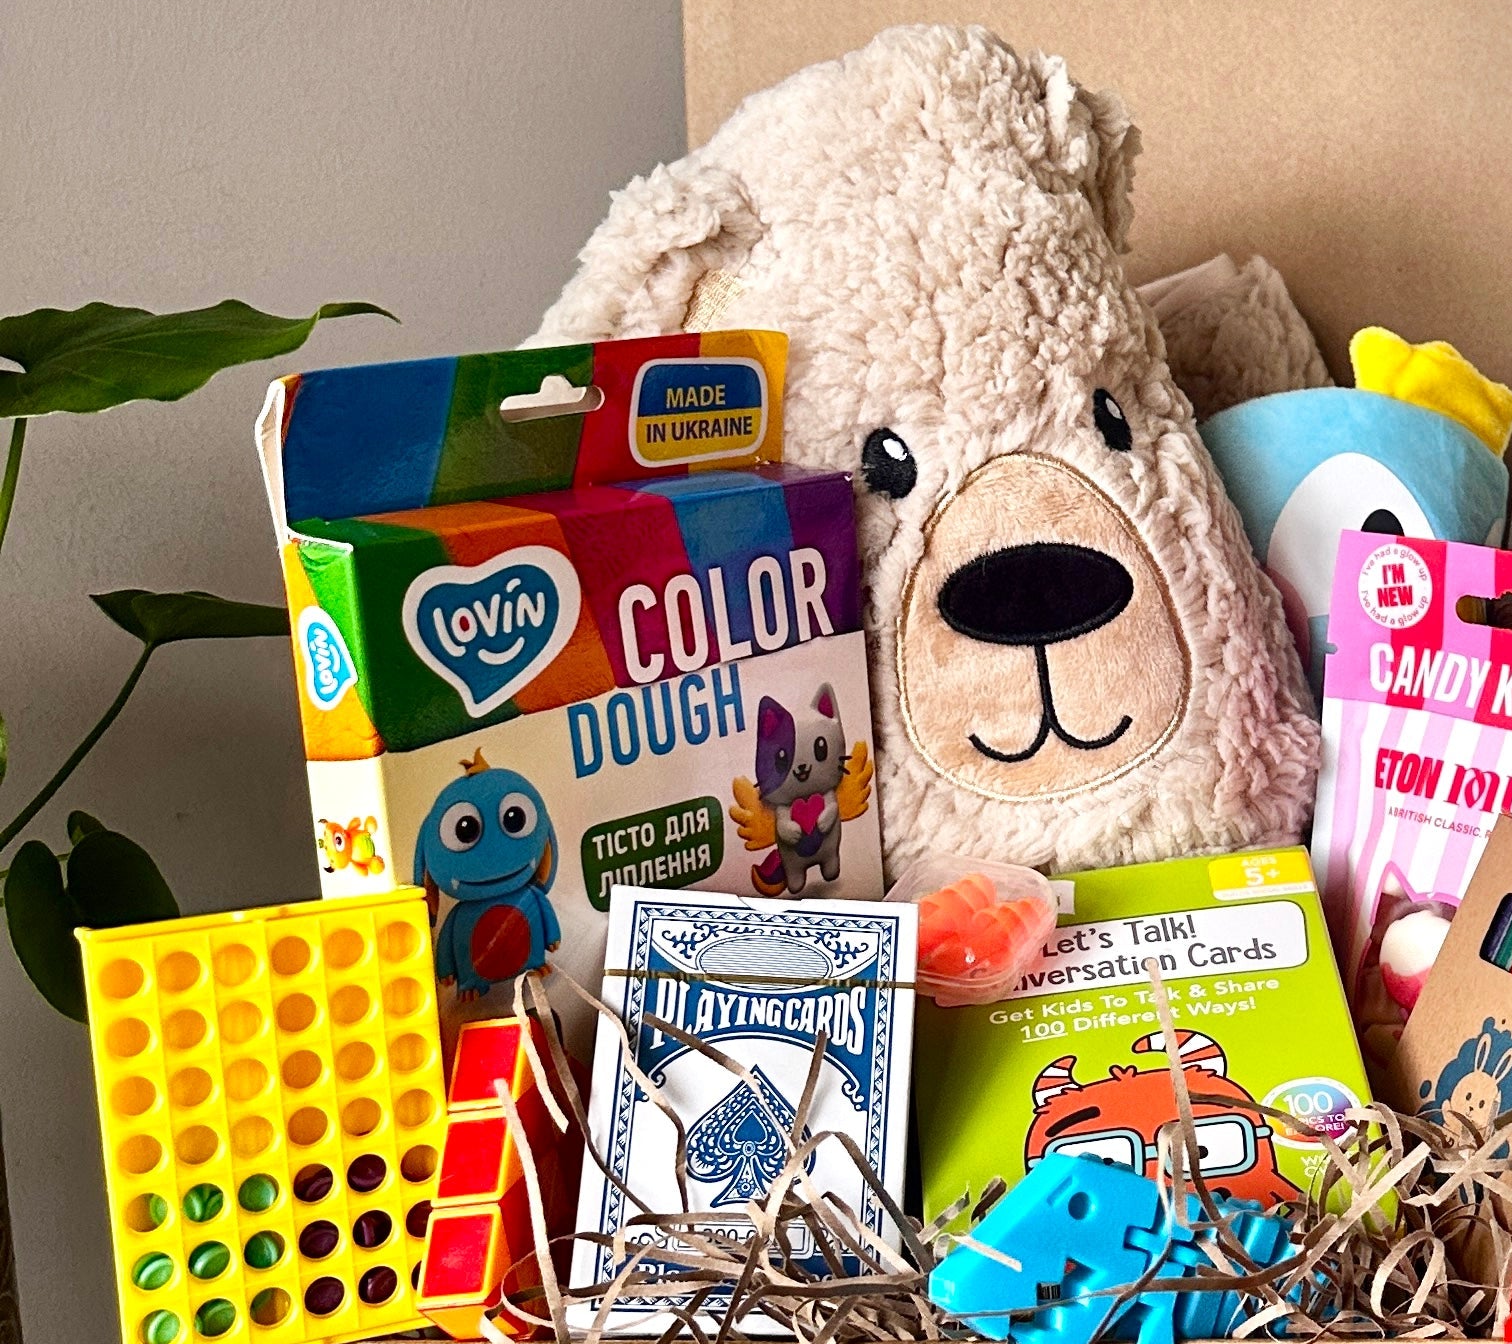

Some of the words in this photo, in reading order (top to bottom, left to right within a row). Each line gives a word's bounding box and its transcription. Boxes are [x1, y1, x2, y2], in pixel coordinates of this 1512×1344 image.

[666, 384, 726, 409] MADE
[646, 422, 666, 443] IN
[671, 415, 753, 441] UKRAINE
[1381, 563, 1405, 585] I'M
[1399, 549, 1420, 566] glow
[1418, 567, 1427, 581] up
[1377, 585, 1413, 608] NEW
[1397, 608, 1419, 627] glow
[1418, 595, 1429, 609] up
[618, 546, 835, 685] COLOR
[1369, 642, 1491, 709] CANDY
[567, 662, 746, 778] DOUGH
[1375, 747, 1444, 800] ETON
[591, 822, 655, 860] ТІСТО
[664, 807, 710, 845] ДЛЯ
[1394, 807, 1432, 825] BRITISH
[1433, 817, 1482, 838] CLASSIC.
[1244, 866, 1281, 886] 5+
[1041, 927, 1114, 958] Let's
[1123, 914, 1197, 946] Talk!
[1187, 937, 1278, 968] Cards
[989, 1008, 1035, 1025] Get
[1042, 999, 1094, 1018] Kids
[1099, 994, 1128, 1009] To
[1189, 983, 1207, 998] &
[1214, 978, 1280, 996] Share
[1020, 1020, 1068, 1040] 100
[1186, 995, 1257, 1016] Ways!
[1283, 1090, 1334, 1116] 100
[1327, 1113, 1345, 1122] TO
